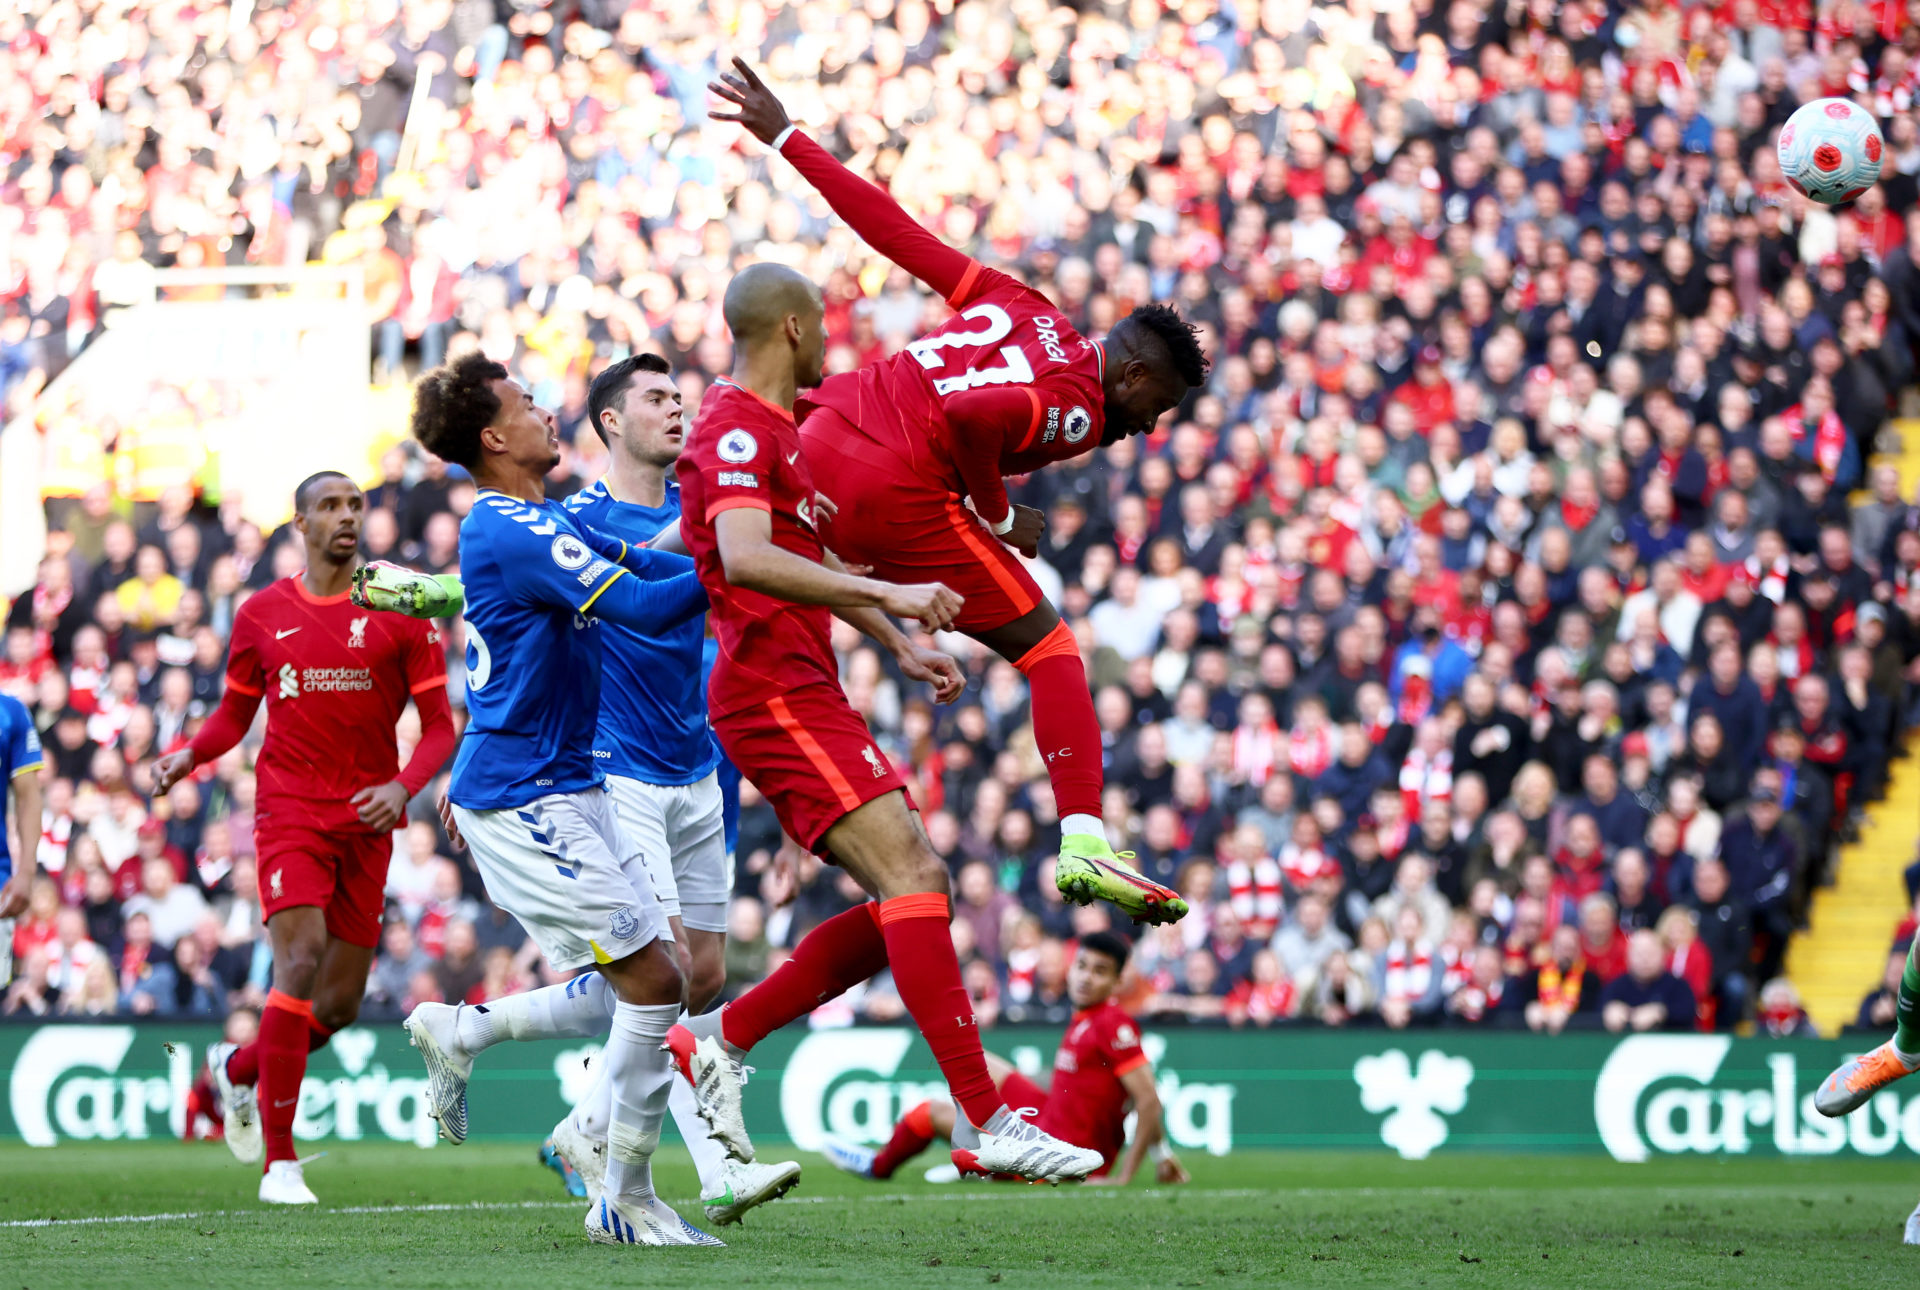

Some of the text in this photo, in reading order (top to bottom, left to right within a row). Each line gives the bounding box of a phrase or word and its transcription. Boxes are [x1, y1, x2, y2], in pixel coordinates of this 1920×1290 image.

[905, 303, 1035, 396] 27
[302, 666, 370, 681] standard
[303, 678, 372, 692] chartered
[9, 1025, 438, 1149] Carlerg
